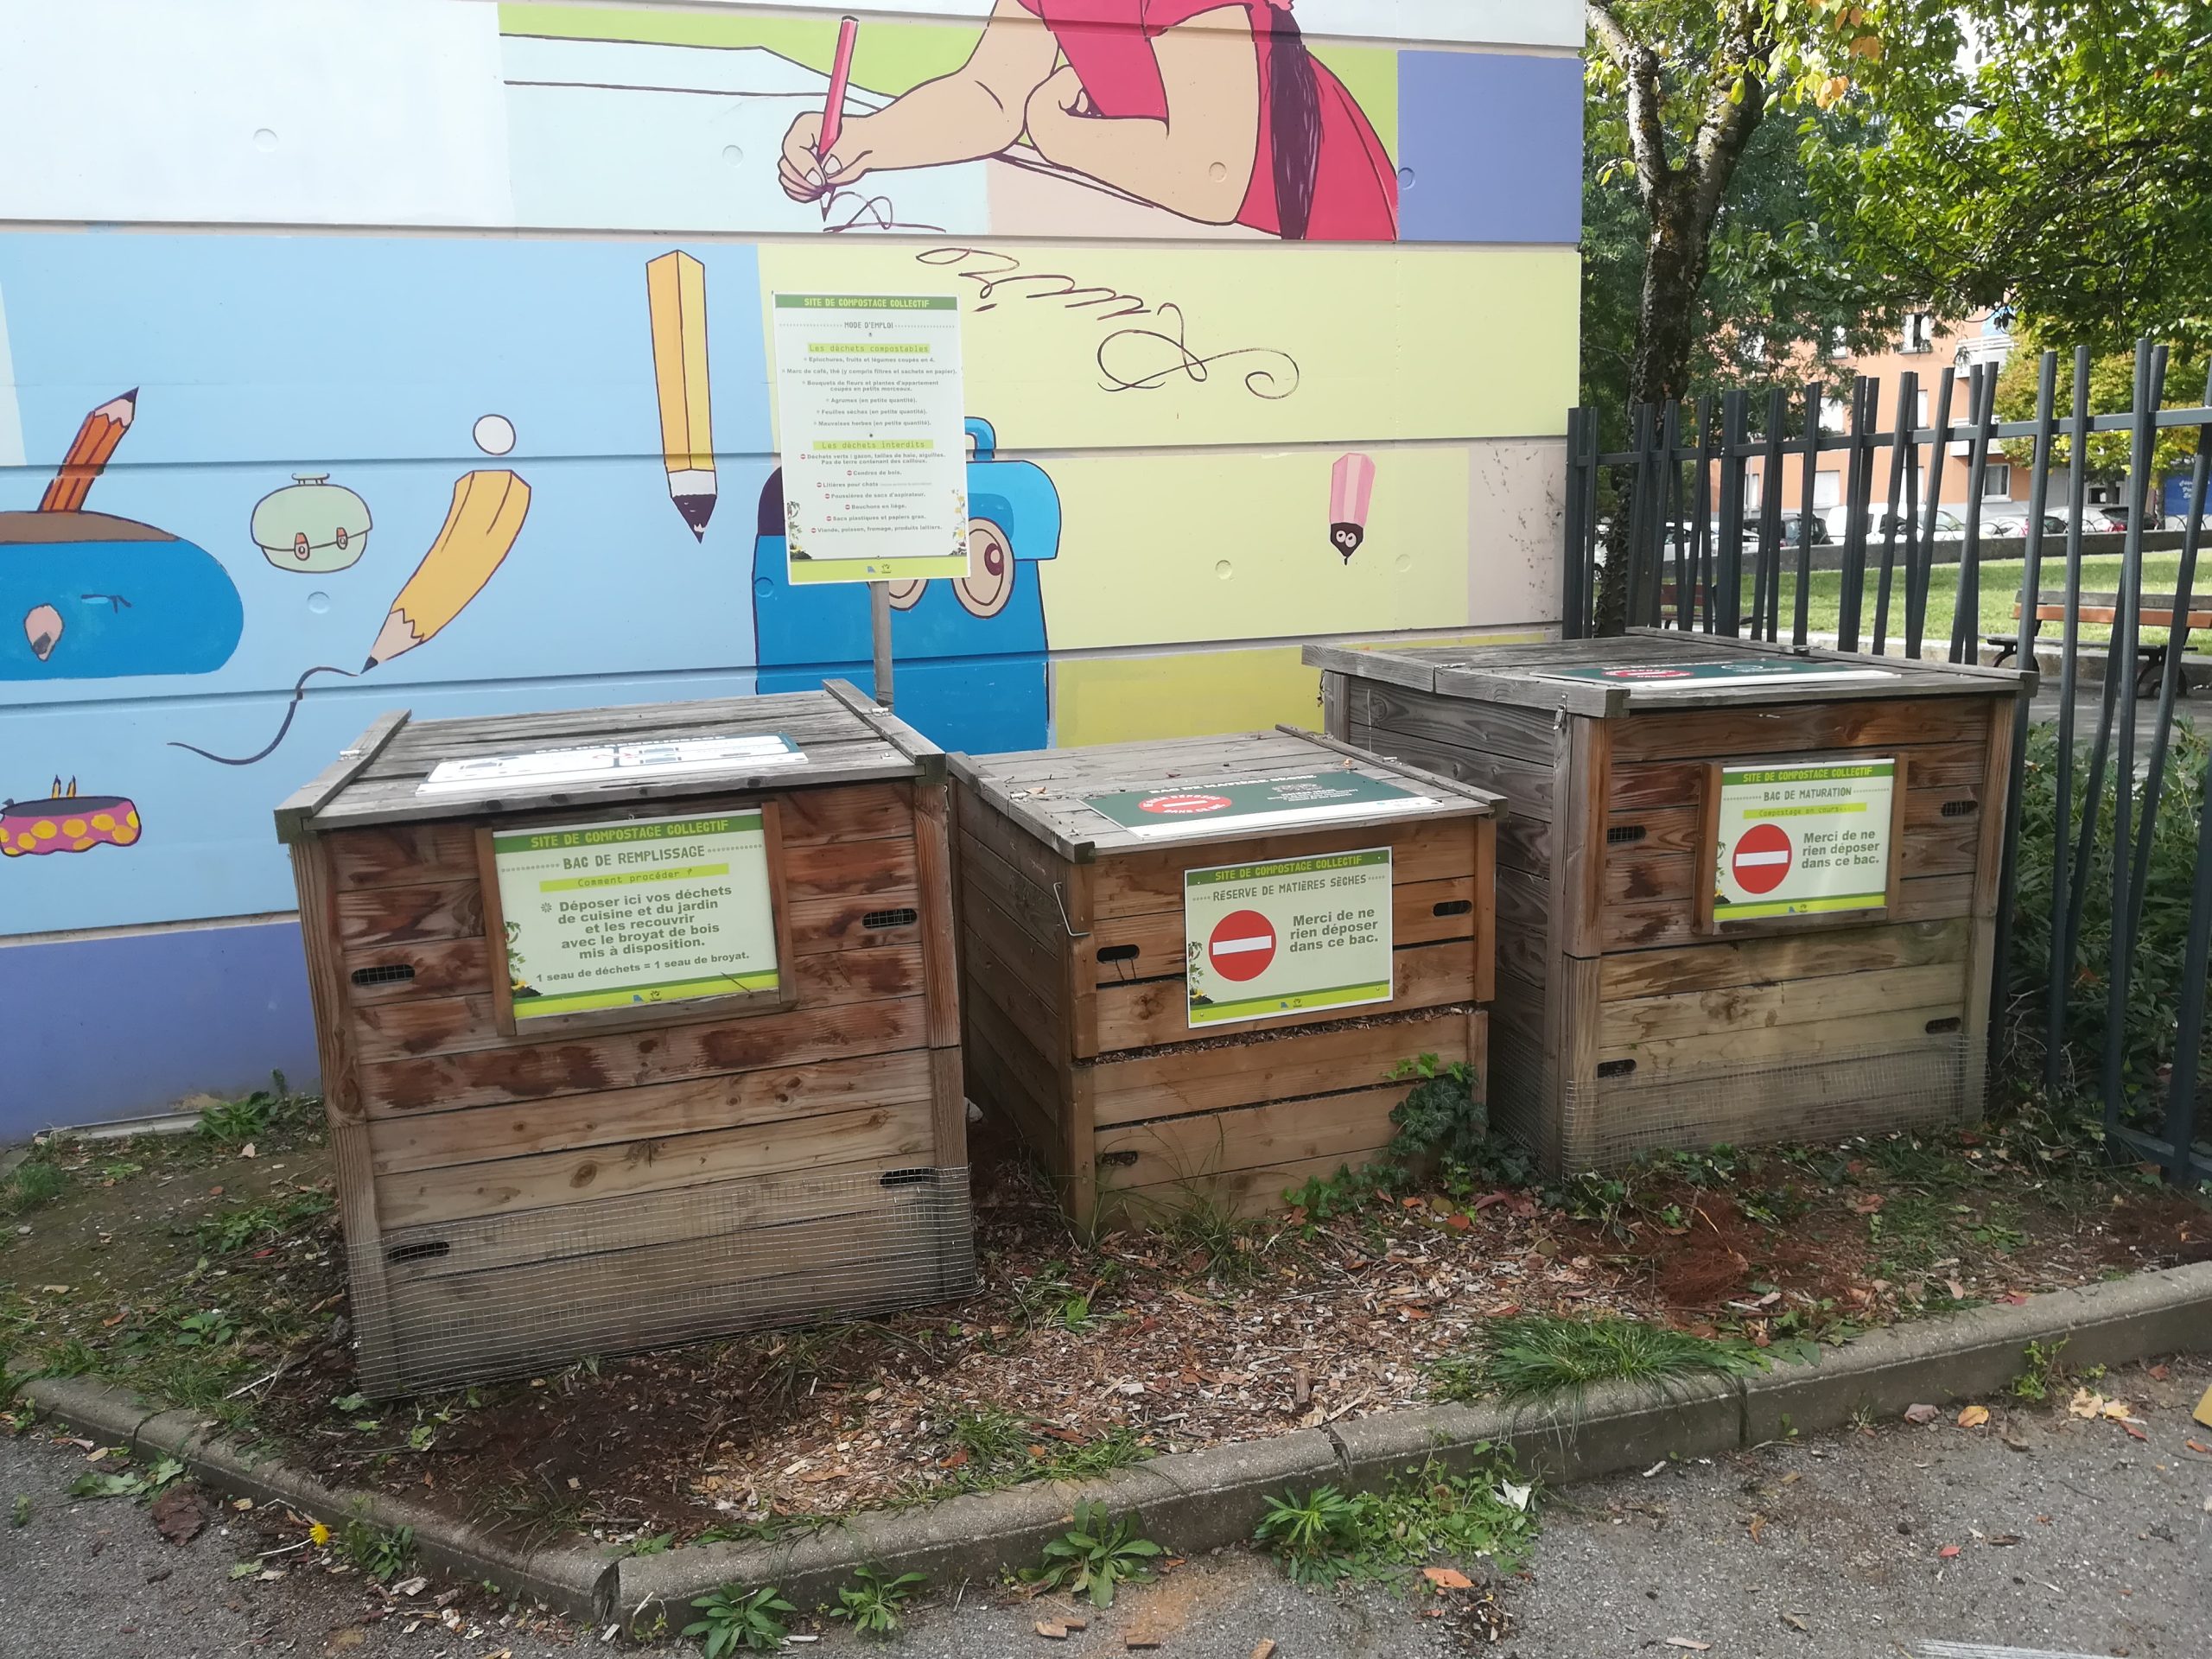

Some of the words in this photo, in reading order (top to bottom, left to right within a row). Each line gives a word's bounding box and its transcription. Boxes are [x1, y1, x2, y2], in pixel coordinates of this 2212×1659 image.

[839, 298, 887, 307] COMPOSTAGE
[1743, 773, 1761, 782] SITE
[1764, 772, 1774, 781] DE
[1778, 768, 1828, 780] COMPOSTAGE
[1832, 766, 1872, 778] COLLECTIF
[1764, 791, 1780, 801] BAC
[1784, 791, 1796, 799] DE
[1800, 787, 1852, 799] MATURATION
[531, 836, 557, 849] SITE
[564, 833, 579, 845] DE
[586, 826, 661, 843] COMPOSTAGE
[667, 820, 728, 836] COLLECTIF
[1803, 831, 1838, 843] Merci
[1842, 830, 1857, 840] de
[1861, 830, 1875, 839] ne
[563, 855, 588, 869] BAC
[595, 854, 611, 867] DE
[619, 845, 705, 865] REMPLISSAGE
[1802, 844, 1827, 856] rien
[1830, 842, 1880, 855] déposer
[1216, 869, 1236, 880] SITE
[1240, 868, 1250, 878] DE
[1255, 861, 1312, 876] COMPOSTAGE
[1316, 855, 1363, 869] COLLECTIF
[1802, 858, 1831, 869] dans
[1835, 856, 1850, 867] ce
[1853, 855, 1879, 865] bac.
[578, 876, 623, 887] Comment
[630, 869, 679, 884] procéder
[1213, 887, 1257, 901] RÉSERVE
[1262, 885, 1274, 896] DE
[1279, 879, 1325, 893] MATIÈRES
[1331, 874, 1366, 888] SÈCHES
[559, 897, 620, 913] Déposer
[625, 894, 641, 906] ici
[646, 893, 671, 903] vos
[676, 885, 732, 900] déchets
[558, 913, 575, 924] de
[581, 908, 632, 922] cuisine
[638, 906, 652, 916] et
[656, 903, 673, 914] du
[677, 899, 718, 914] jardin
[1293, 912, 1332, 926] Merci
[1337, 910, 1353, 920] de
[1357, 908, 1375, 918] ne
[585, 924, 600, 934] et
[605, 920, 626, 931] les
[630, 914, 695, 929] recouvrir
[1290, 927, 1317, 939] rien
[1322, 919, 1378, 938] déposer
[562, 937, 596, 949] avec
[601, 934, 613, 944] le
[619, 930, 664, 945] broyat
[669, 927, 686, 938] de
[690, 923, 720, 935] bois
[1290, 940, 1323, 953] dans
[1327, 938, 1344, 948] ce
[1349, 933, 1378, 945] bac.
[580, 947, 605, 960] mis
[610, 944, 619, 957] à
[623, 938, 705, 955] disposition.
[547, 971, 574, 981] seau
[578, 967, 591, 977] de
[595, 962, 640, 976] déchets
[664, 958, 690, 968] seau
[694, 954, 708, 964] de
[711, 951, 749, 964] broyat.
